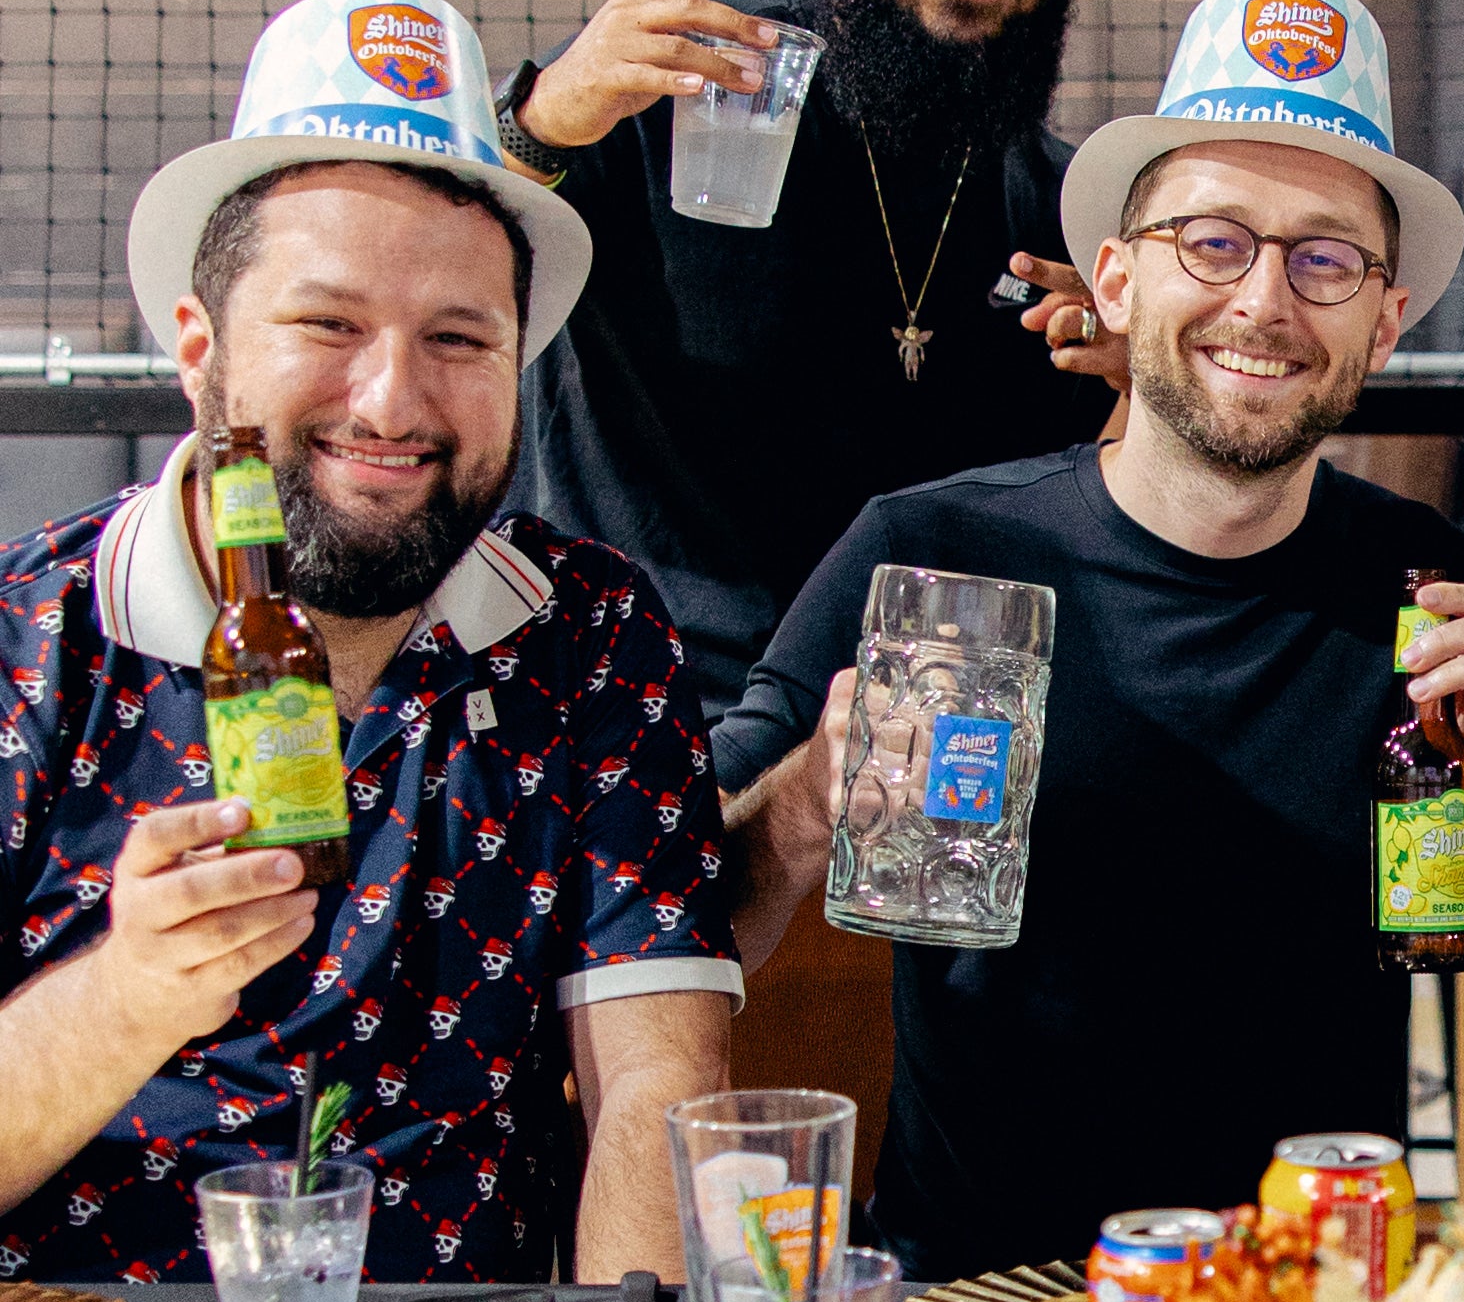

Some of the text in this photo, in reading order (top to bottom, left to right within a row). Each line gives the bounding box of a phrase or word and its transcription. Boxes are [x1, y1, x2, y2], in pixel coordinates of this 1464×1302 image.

[1256, 0, 1335, 26] Shiner
[363, 13, 447, 41] Shiner
[1248, 28, 1337, 60] Oktoberfest
[357, 42, 451, 75] Oktoberfes
[946, 733, 999, 752] Shiner
[941, 753, 998, 770] Oktoberfest
